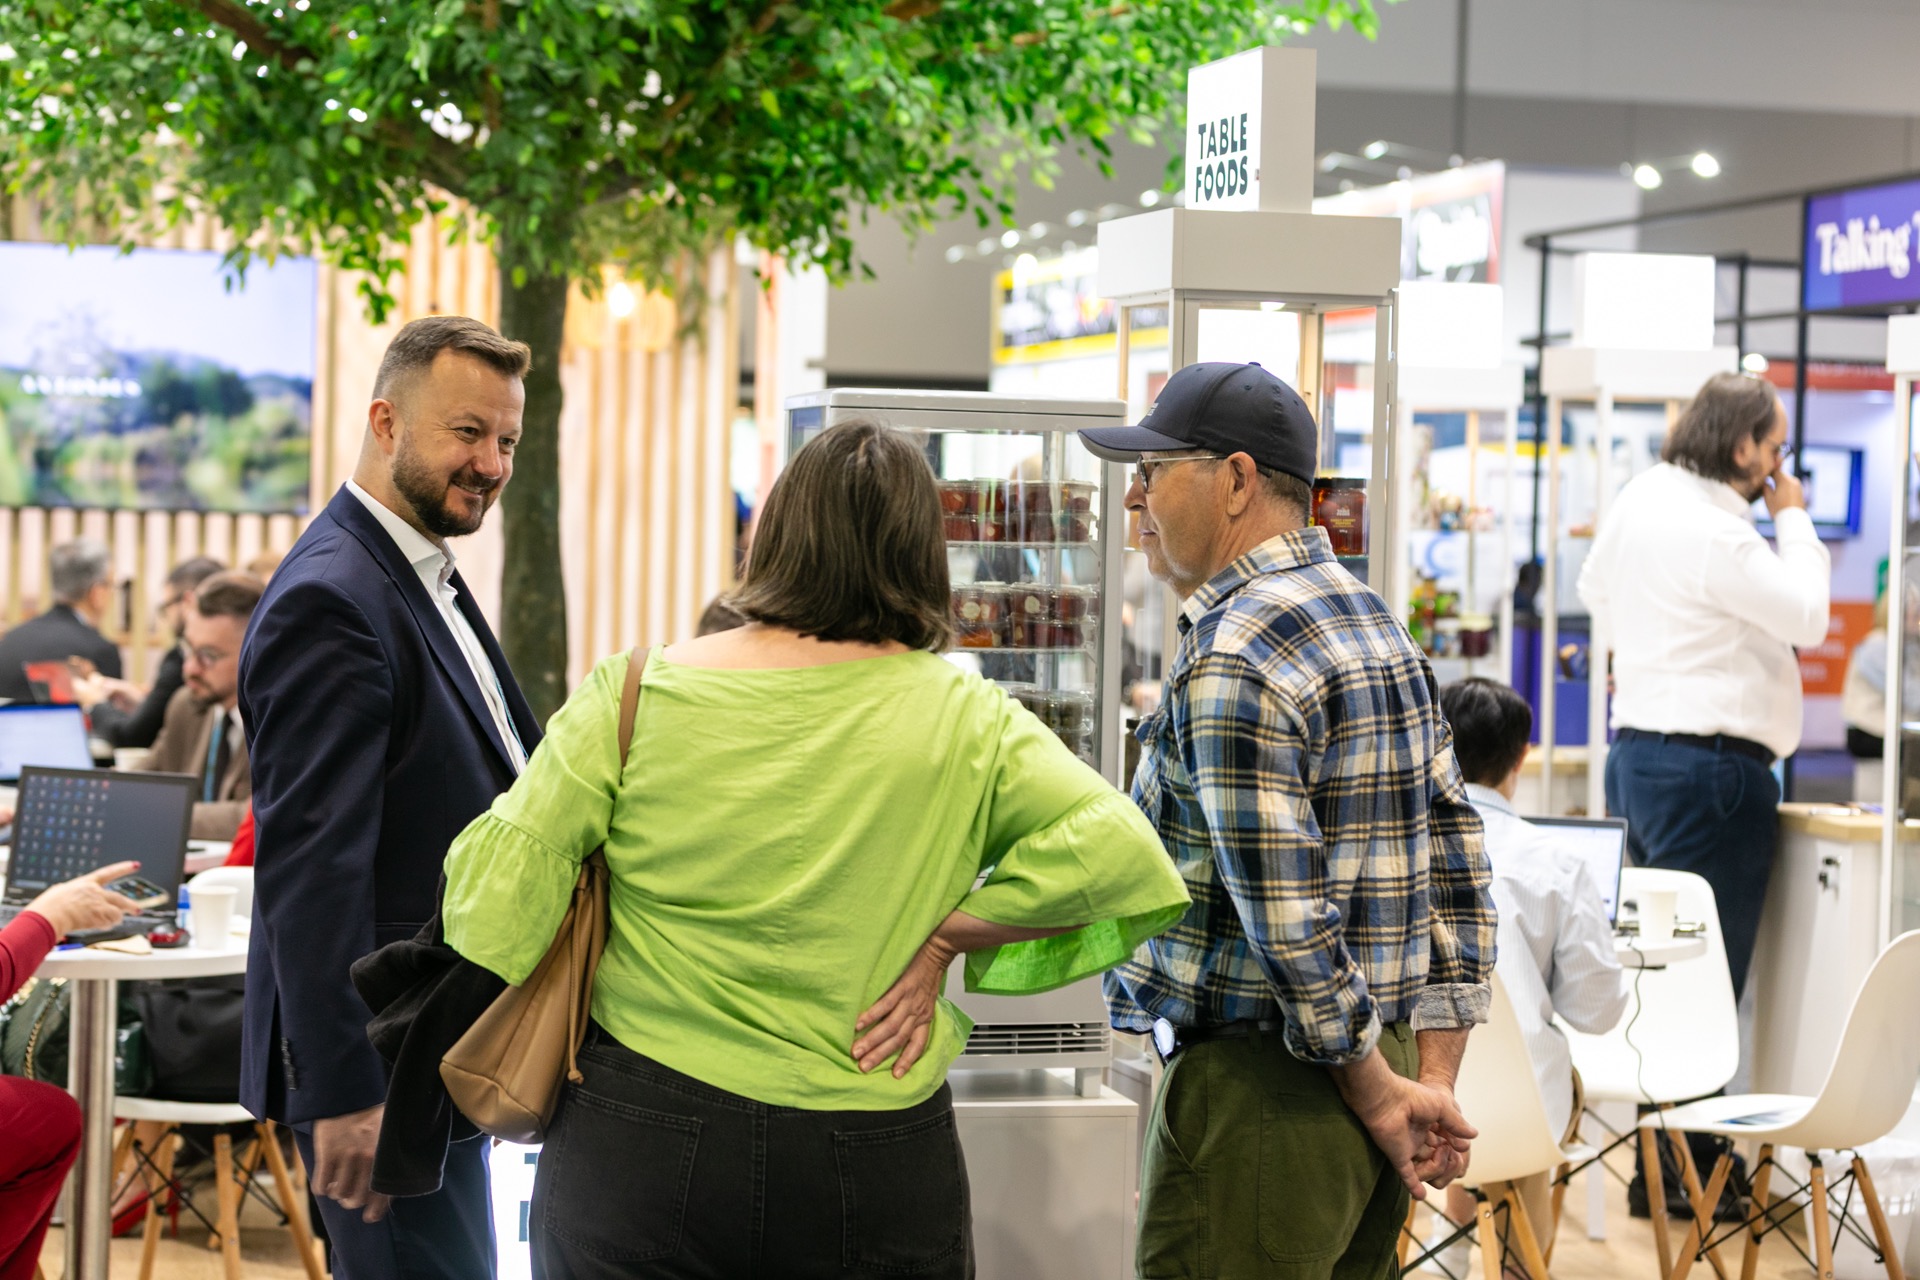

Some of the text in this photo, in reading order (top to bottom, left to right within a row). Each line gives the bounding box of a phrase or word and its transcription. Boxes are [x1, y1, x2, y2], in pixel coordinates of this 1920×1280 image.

[1198, 113, 1248, 160] TABLE
[1195, 155, 1248, 203] FOODS
[1815, 214, 1912, 279] Talking
